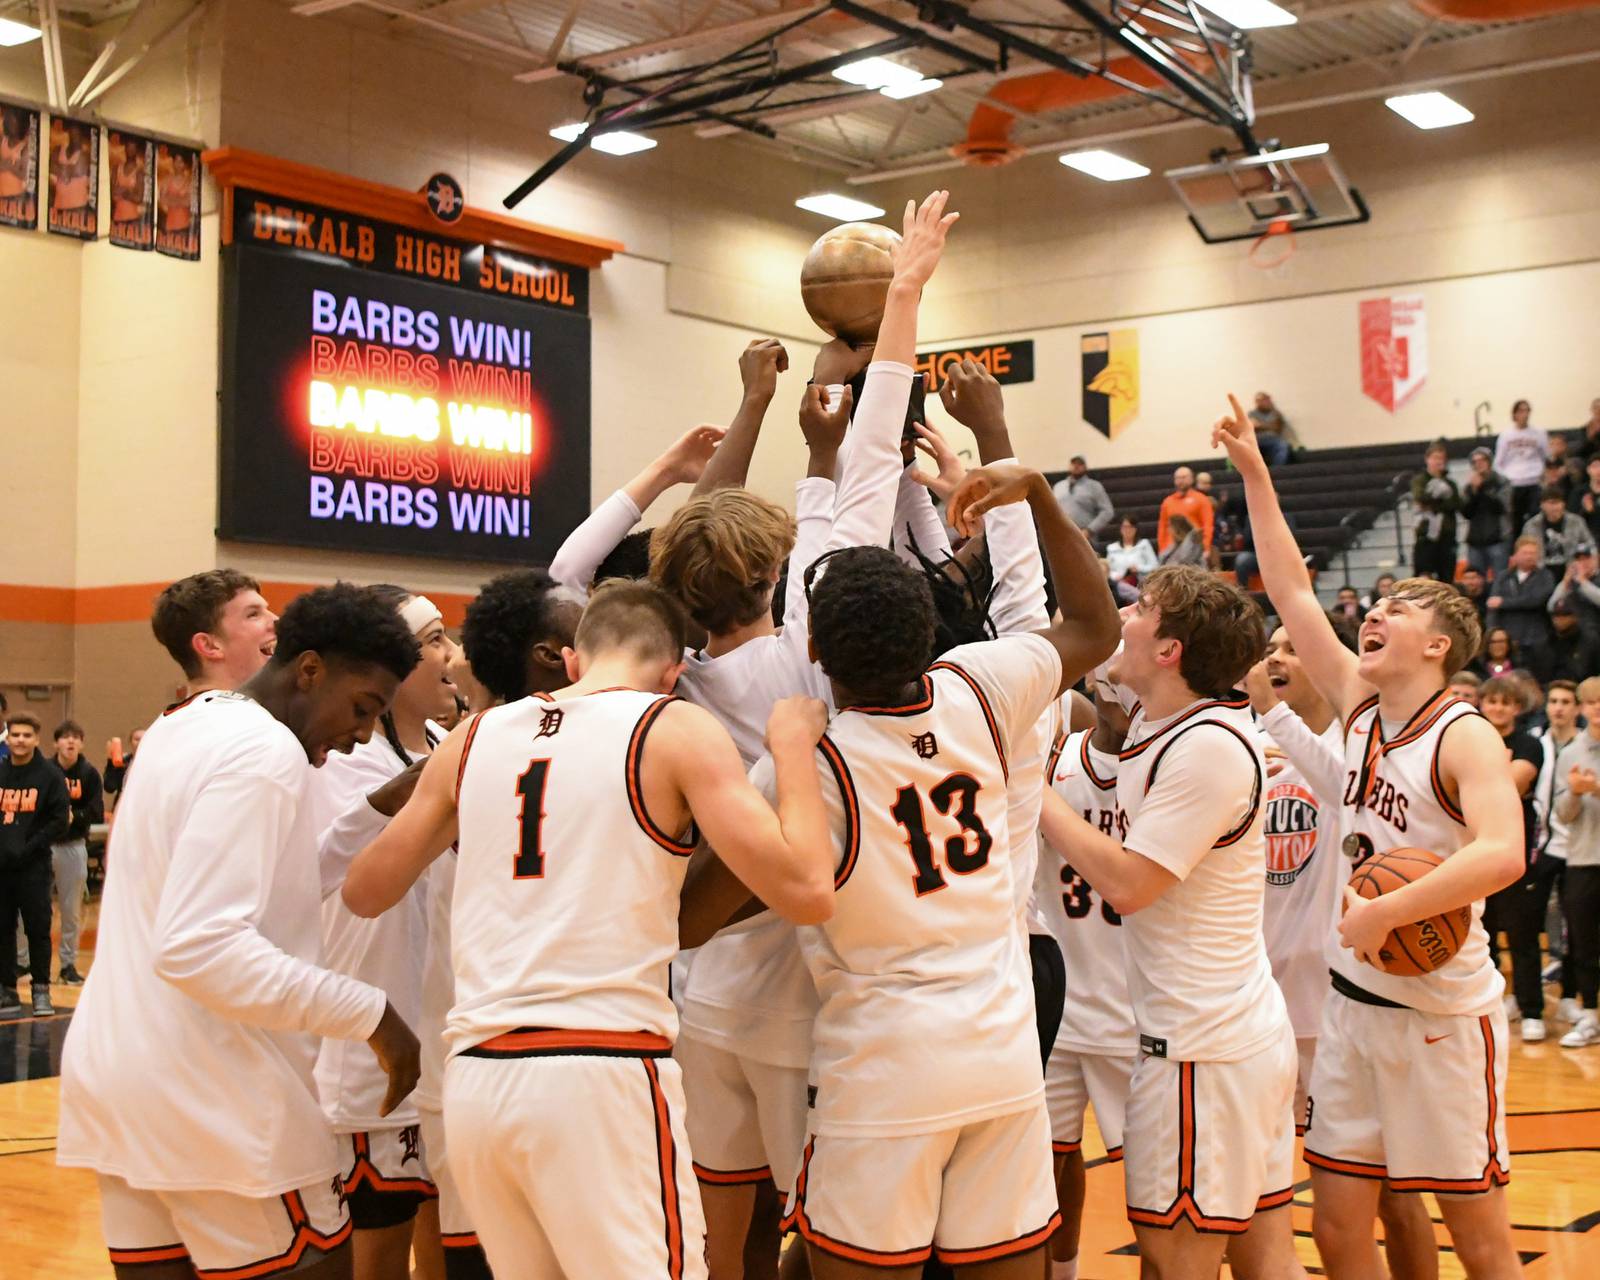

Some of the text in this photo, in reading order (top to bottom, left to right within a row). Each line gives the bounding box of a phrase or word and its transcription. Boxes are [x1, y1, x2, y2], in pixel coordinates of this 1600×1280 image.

[253, 201, 575, 307] DEKALB HIGH SCHOOL
[312, 289, 531, 368] BARBS WIN!
[311, 334, 531, 409] BARBS WIN!
[309, 380, 532, 455] BARBS WIN!
[310, 431, 531, 496] BARBS WIN!
[309, 475, 531, 538] BARBS WIN!
[533, 706, 565, 742] D
[909, 731, 939, 760] D
[513, 757, 552, 880] 1
[889, 770, 993, 898] 13
